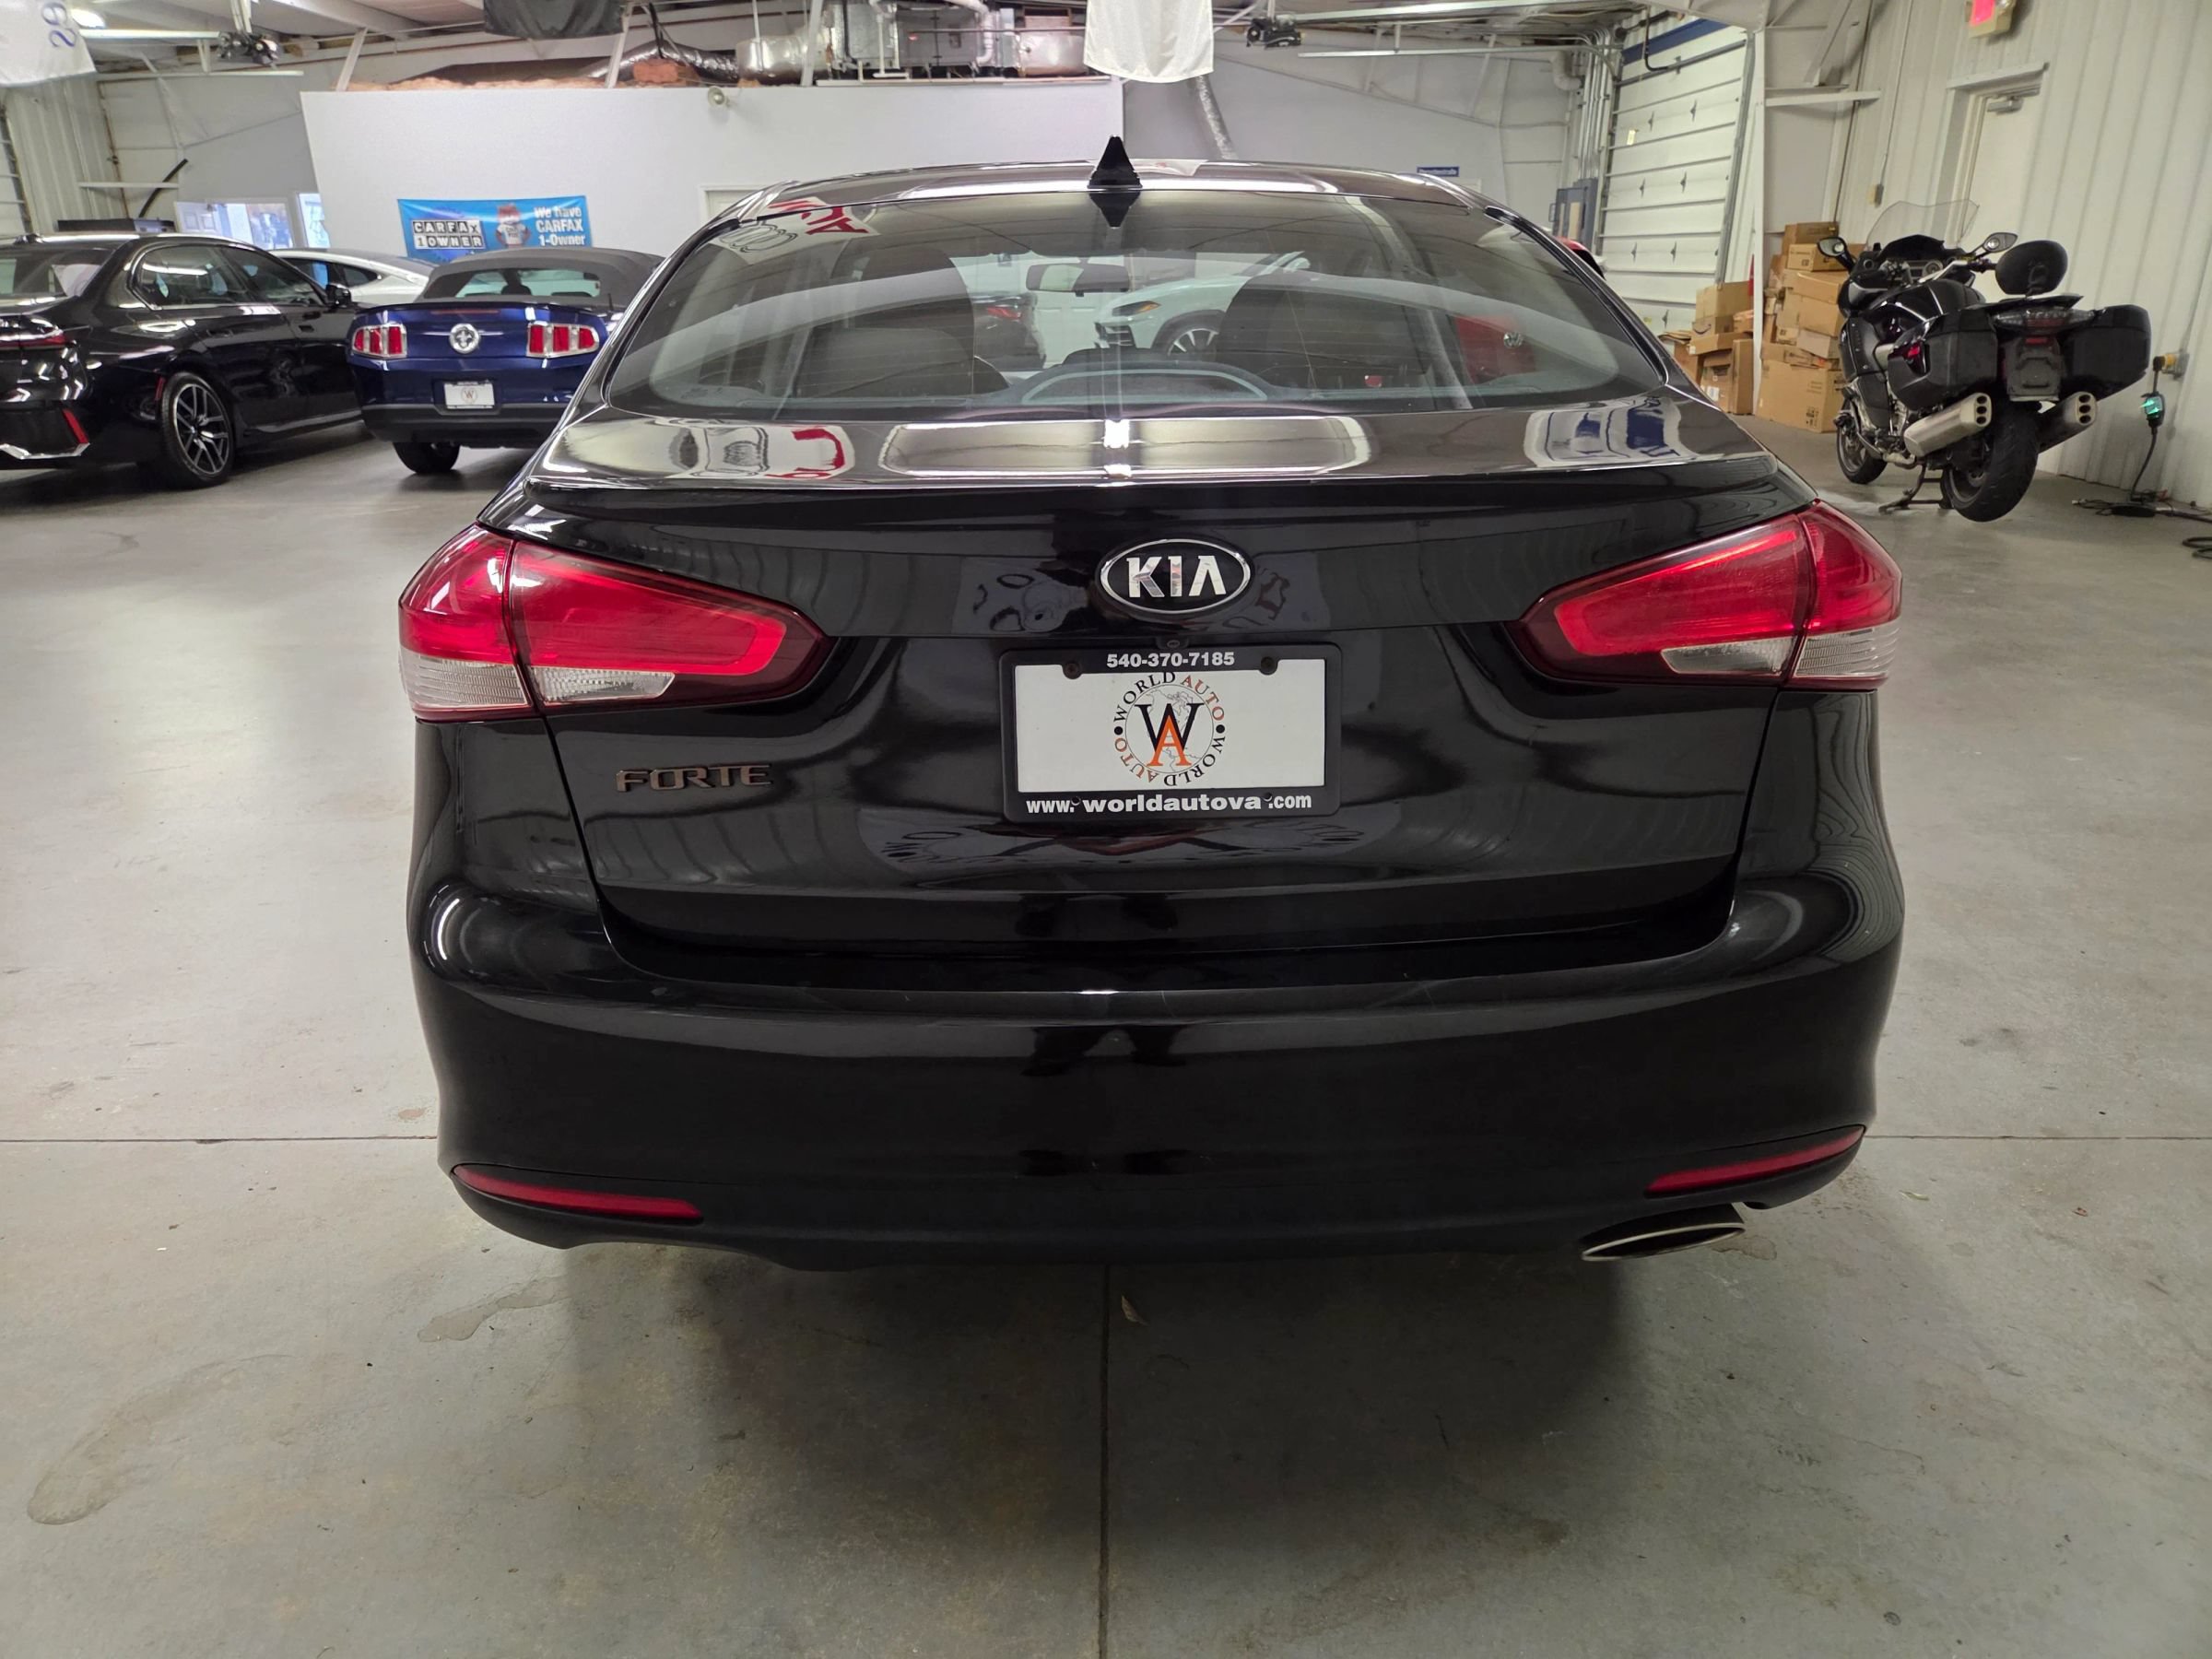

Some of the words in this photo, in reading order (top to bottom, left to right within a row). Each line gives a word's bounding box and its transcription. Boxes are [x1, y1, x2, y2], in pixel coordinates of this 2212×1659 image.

[535, 206, 551, 218] We
[555, 206, 582, 218] have
[413, 220, 481, 234] CARFAX
[535, 219, 583, 232] CARFAX
[538, 234, 585, 246] 1-Owner
[1126, 555, 1227, 598] KIA
[1106, 651, 1235, 669] 540-370-7185
[1113, 672, 1176, 723] WORLD
[1181, 675, 1225, 721] AUTO
[1114, 737, 1159, 782] AUTO
[1164, 736, 1226, 786] WORLD
[616, 764, 771, 792] FORTE
